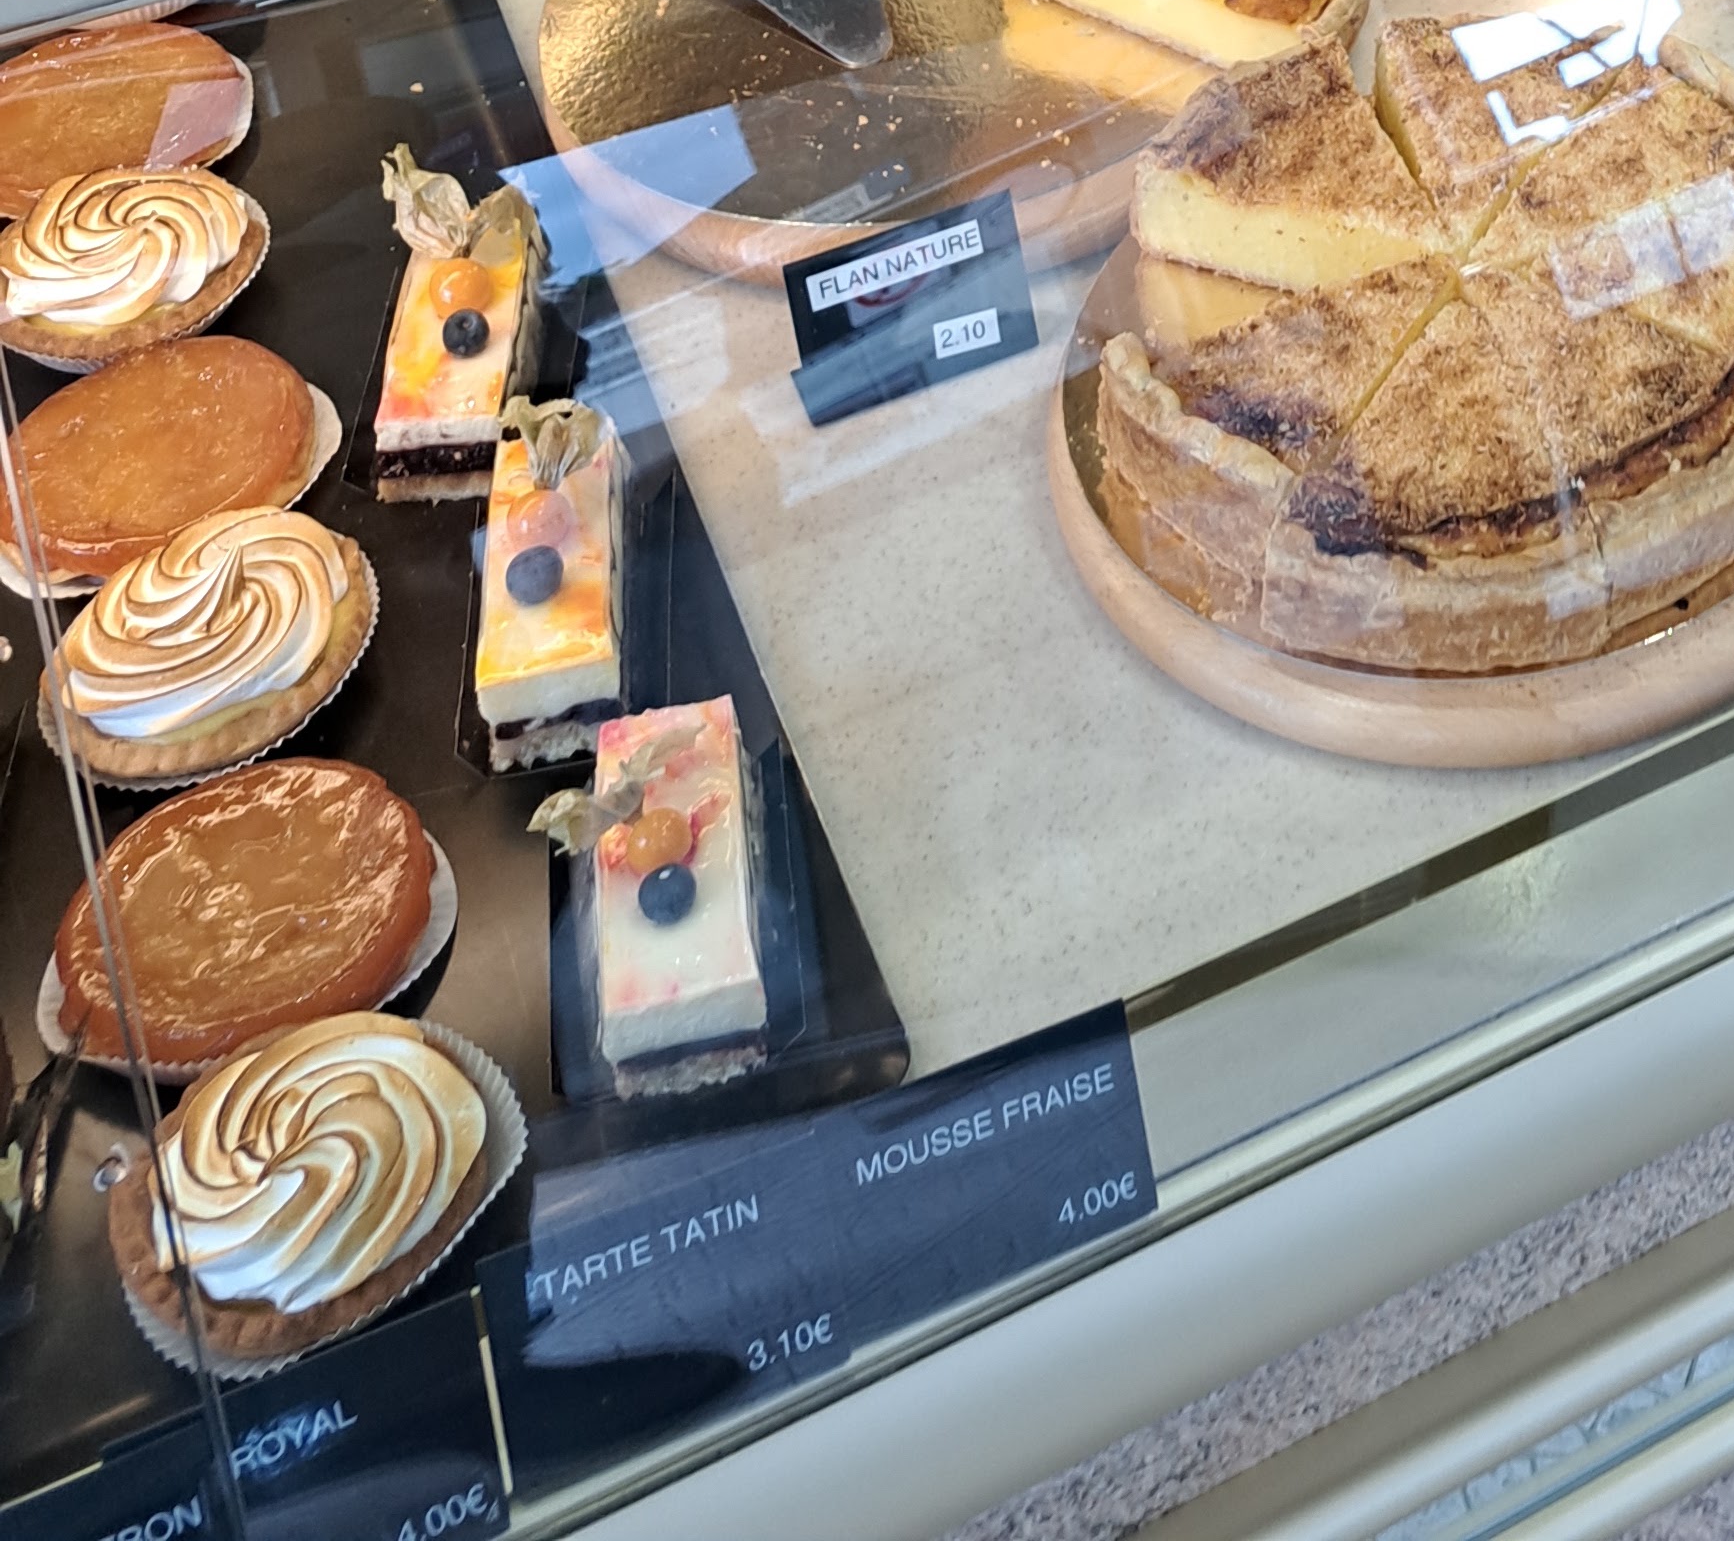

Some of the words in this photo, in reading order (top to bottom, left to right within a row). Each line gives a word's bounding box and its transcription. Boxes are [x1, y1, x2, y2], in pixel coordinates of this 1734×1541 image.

[818, 261, 880, 301] FLAN
[883, 228, 981, 277] NATURE
[938, 319, 987, 351] 2.10
[853, 1106, 996, 1187] MOUSSE
[1000, 1061, 1117, 1131] FRAISE
[1056, 1170, 1139, 1228] 4.00€
[538, 1233, 653, 1302] TARTE
[659, 1194, 760, 1255] TATIN
[746, 1312, 835, 1375] 3.10€
[231, 1397, 359, 1481] ROYAL
